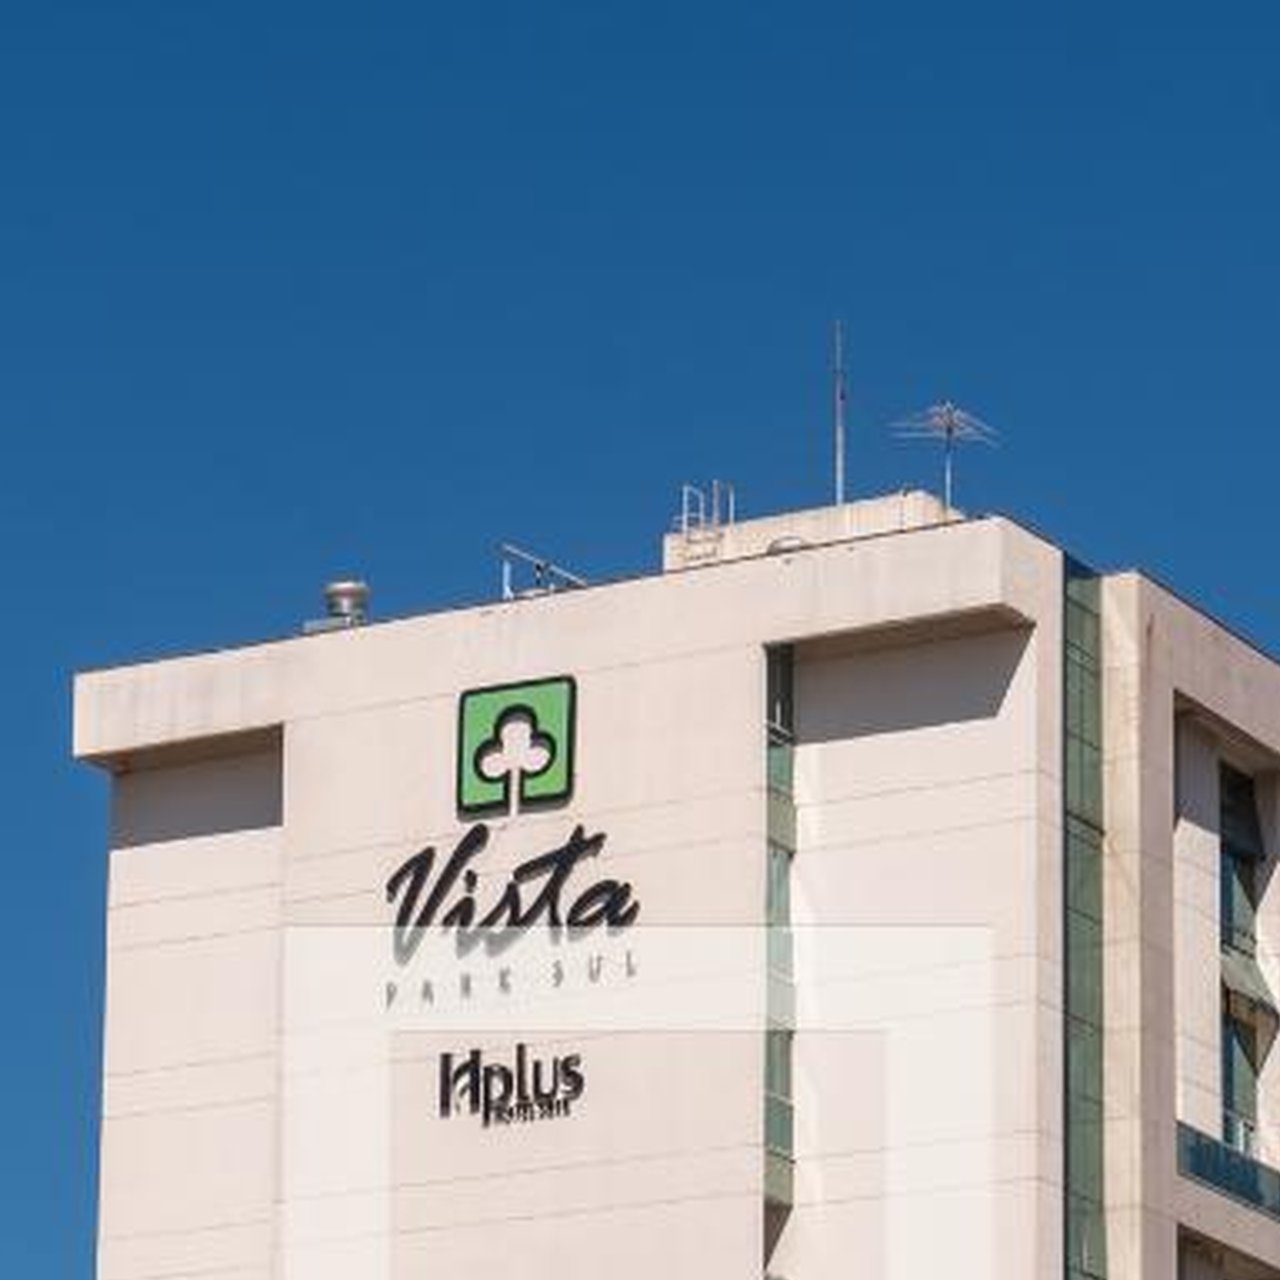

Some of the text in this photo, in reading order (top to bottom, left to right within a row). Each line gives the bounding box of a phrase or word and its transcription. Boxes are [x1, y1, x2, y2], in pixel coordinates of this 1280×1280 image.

[385, 823, 640, 965] Vista
[385, 950, 637, 1009] PARK SUL
[439, 1043, 585, 1128] Hplus
